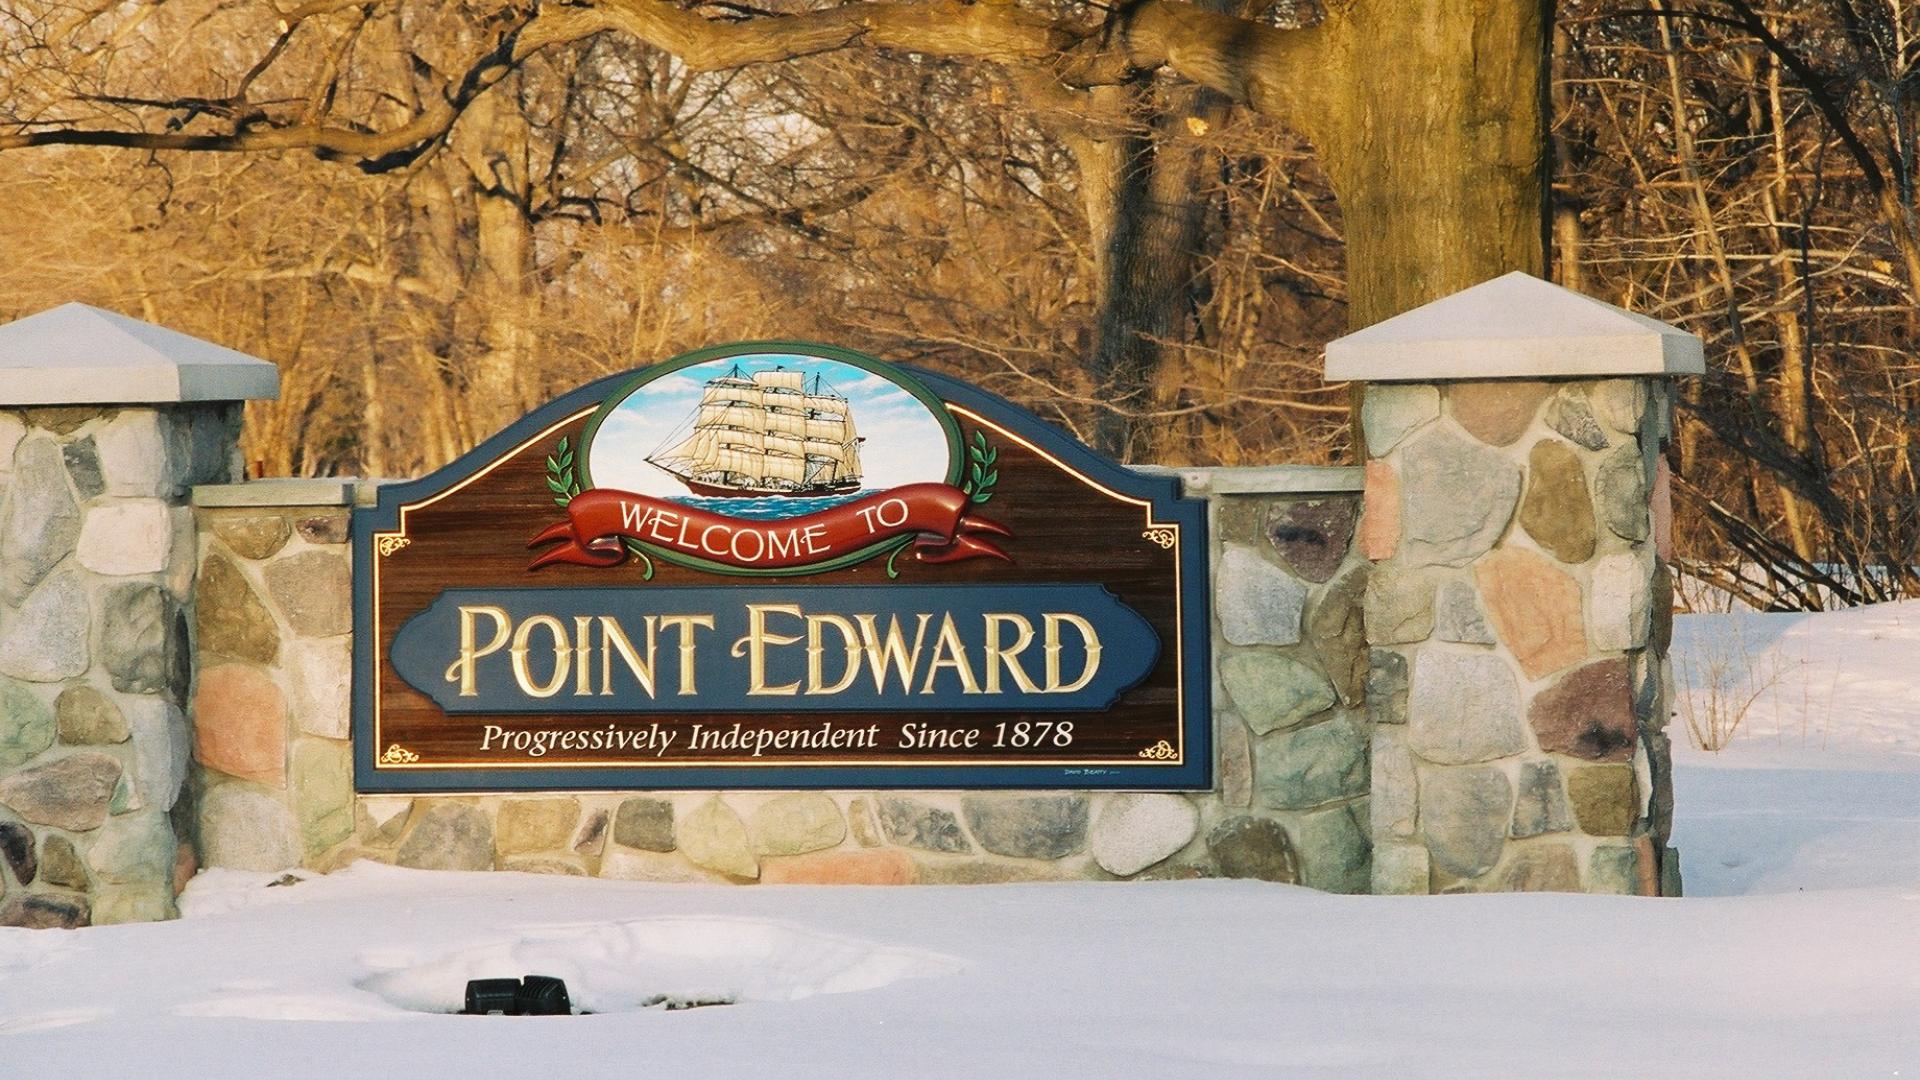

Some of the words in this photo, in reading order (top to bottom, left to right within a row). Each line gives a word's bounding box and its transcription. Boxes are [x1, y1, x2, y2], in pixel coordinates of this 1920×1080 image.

[620, 501, 831, 562] WELCOME
[856, 498, 909, 534] TO
[445, 604, 715, 700] POINT
[731, 603, 1103, 696] EDWARD
[480, 724, 677, 757] Progressively
[687, 723, 880, 757] Independent
[899, 722, 980, 749] Since
[992, 721, 1074, 748] 1878
